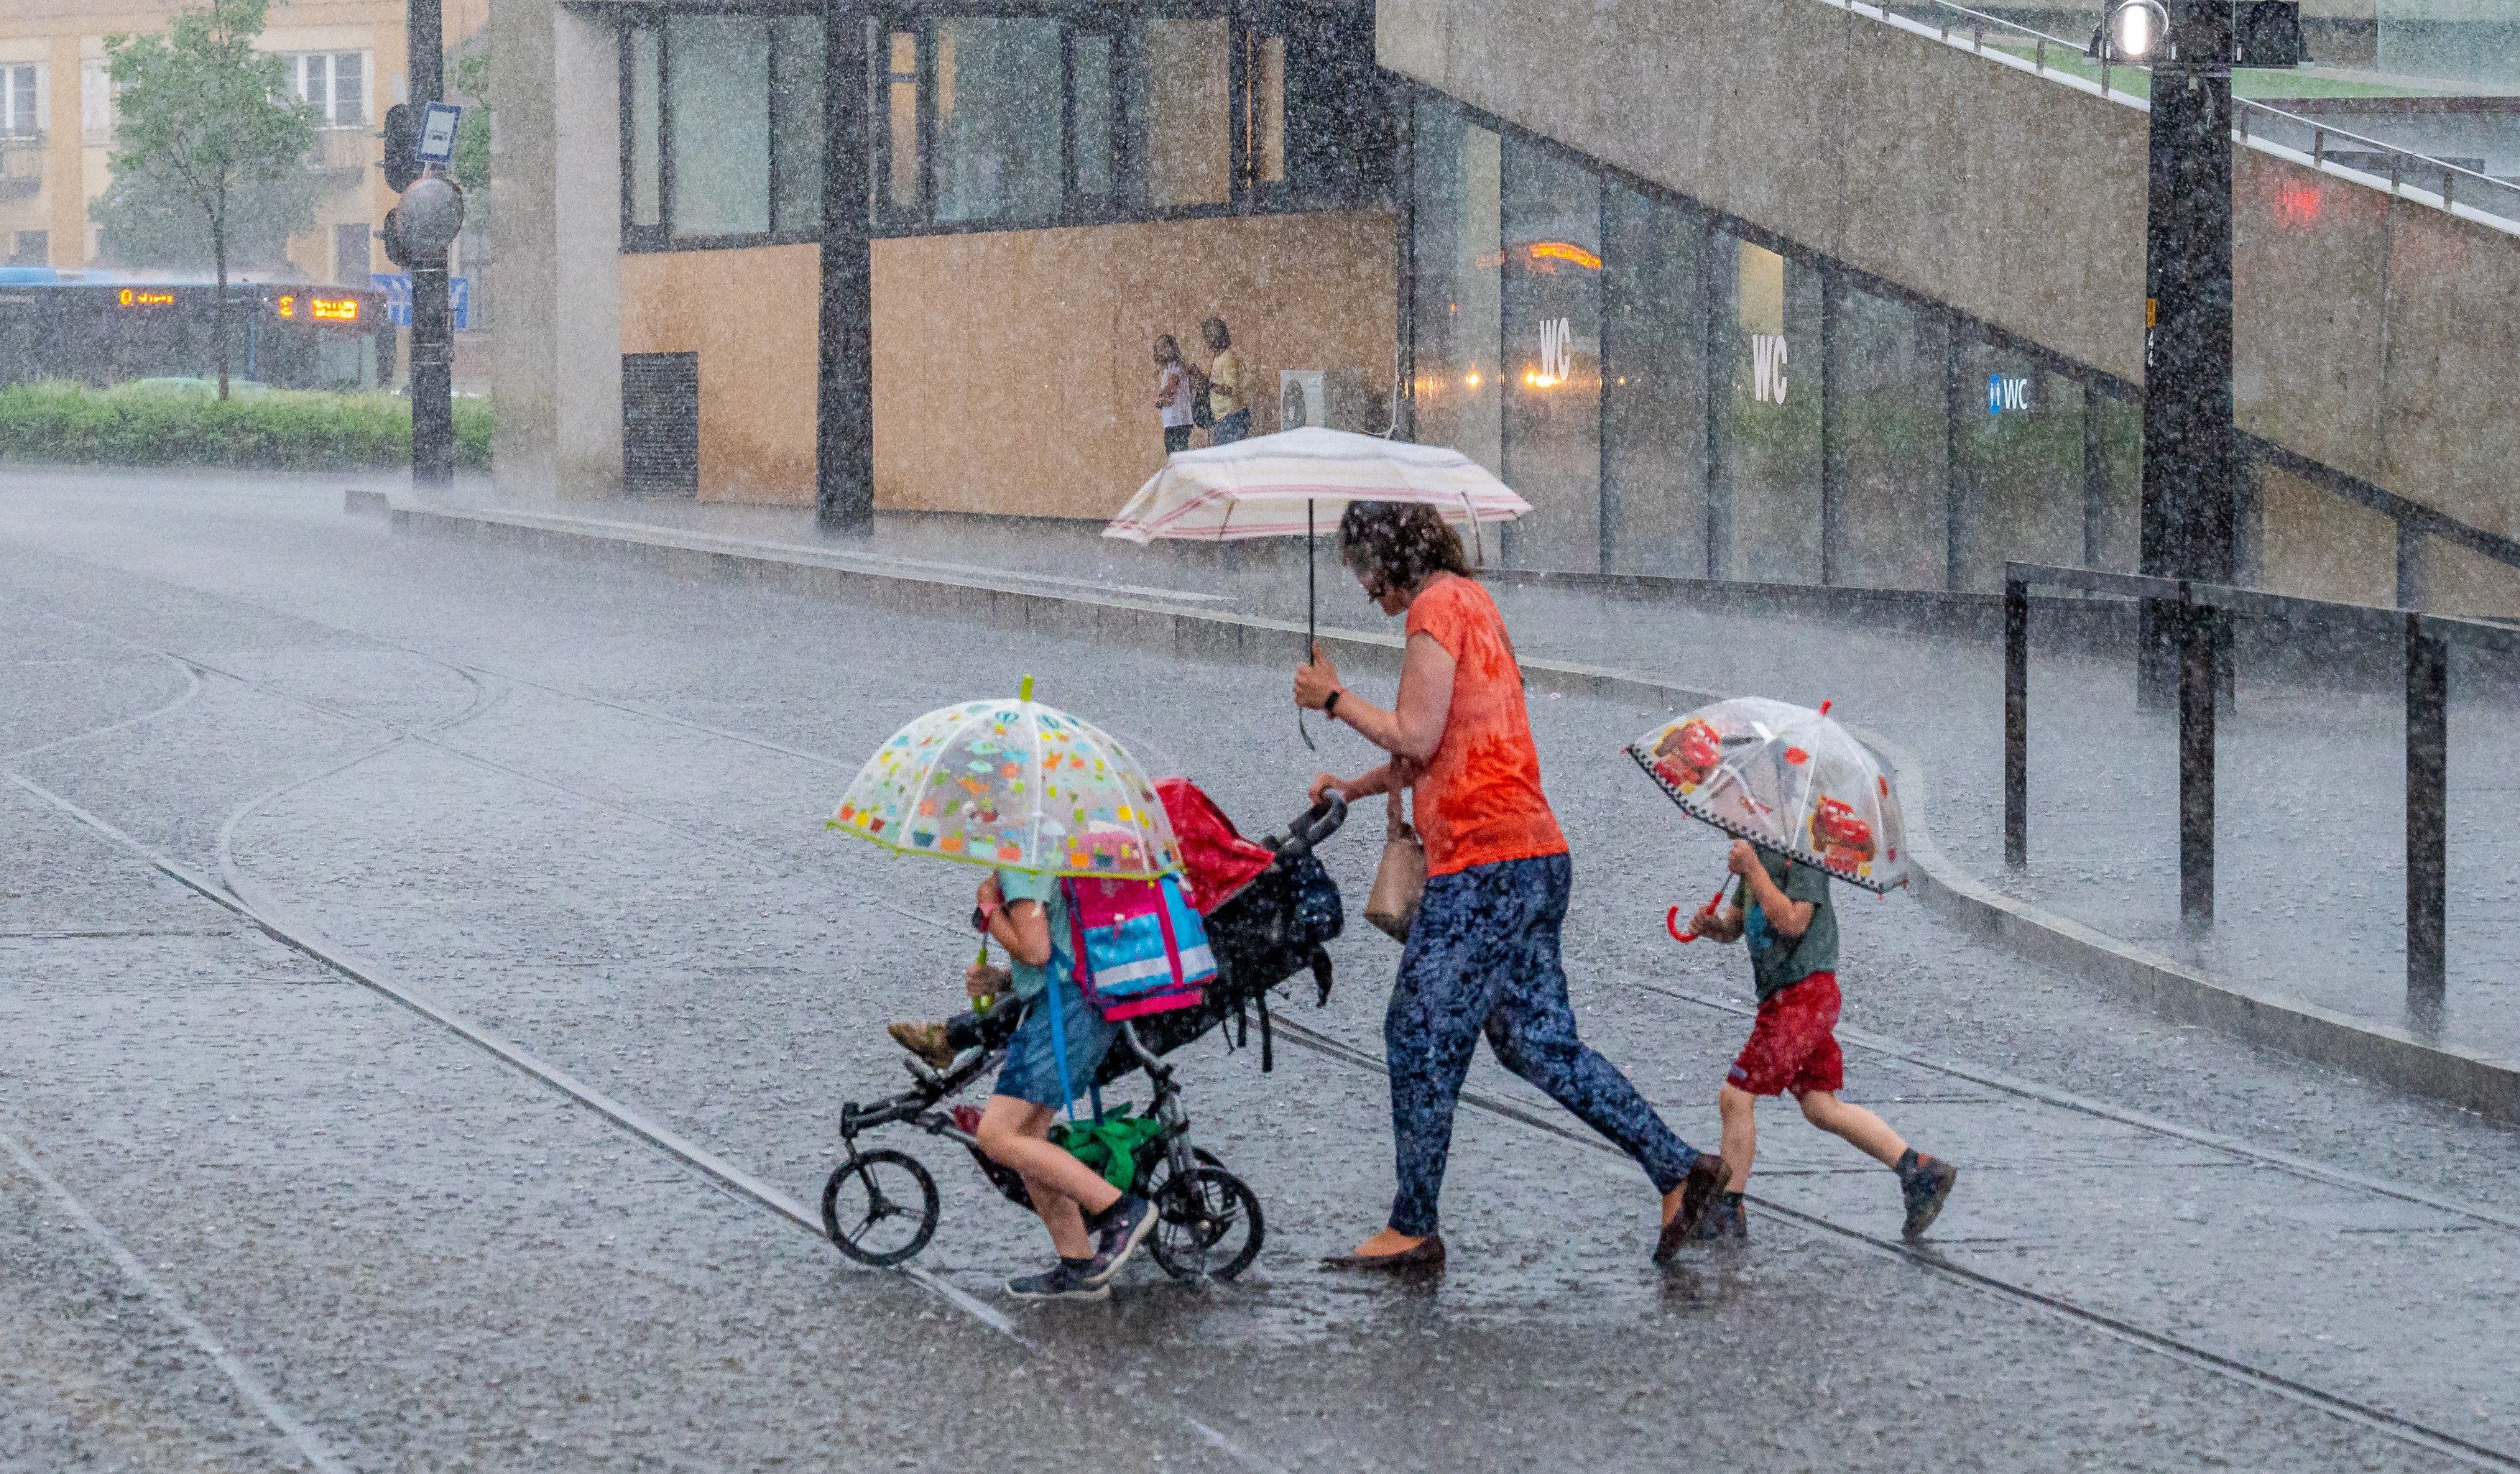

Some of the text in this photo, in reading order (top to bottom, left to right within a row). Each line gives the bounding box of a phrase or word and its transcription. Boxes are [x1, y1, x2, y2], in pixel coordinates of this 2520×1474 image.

[1539, 317, 1570, 381] WC
[1753, 334, 1788, 405] WC
[2003, 379, 2028, 410] WC
